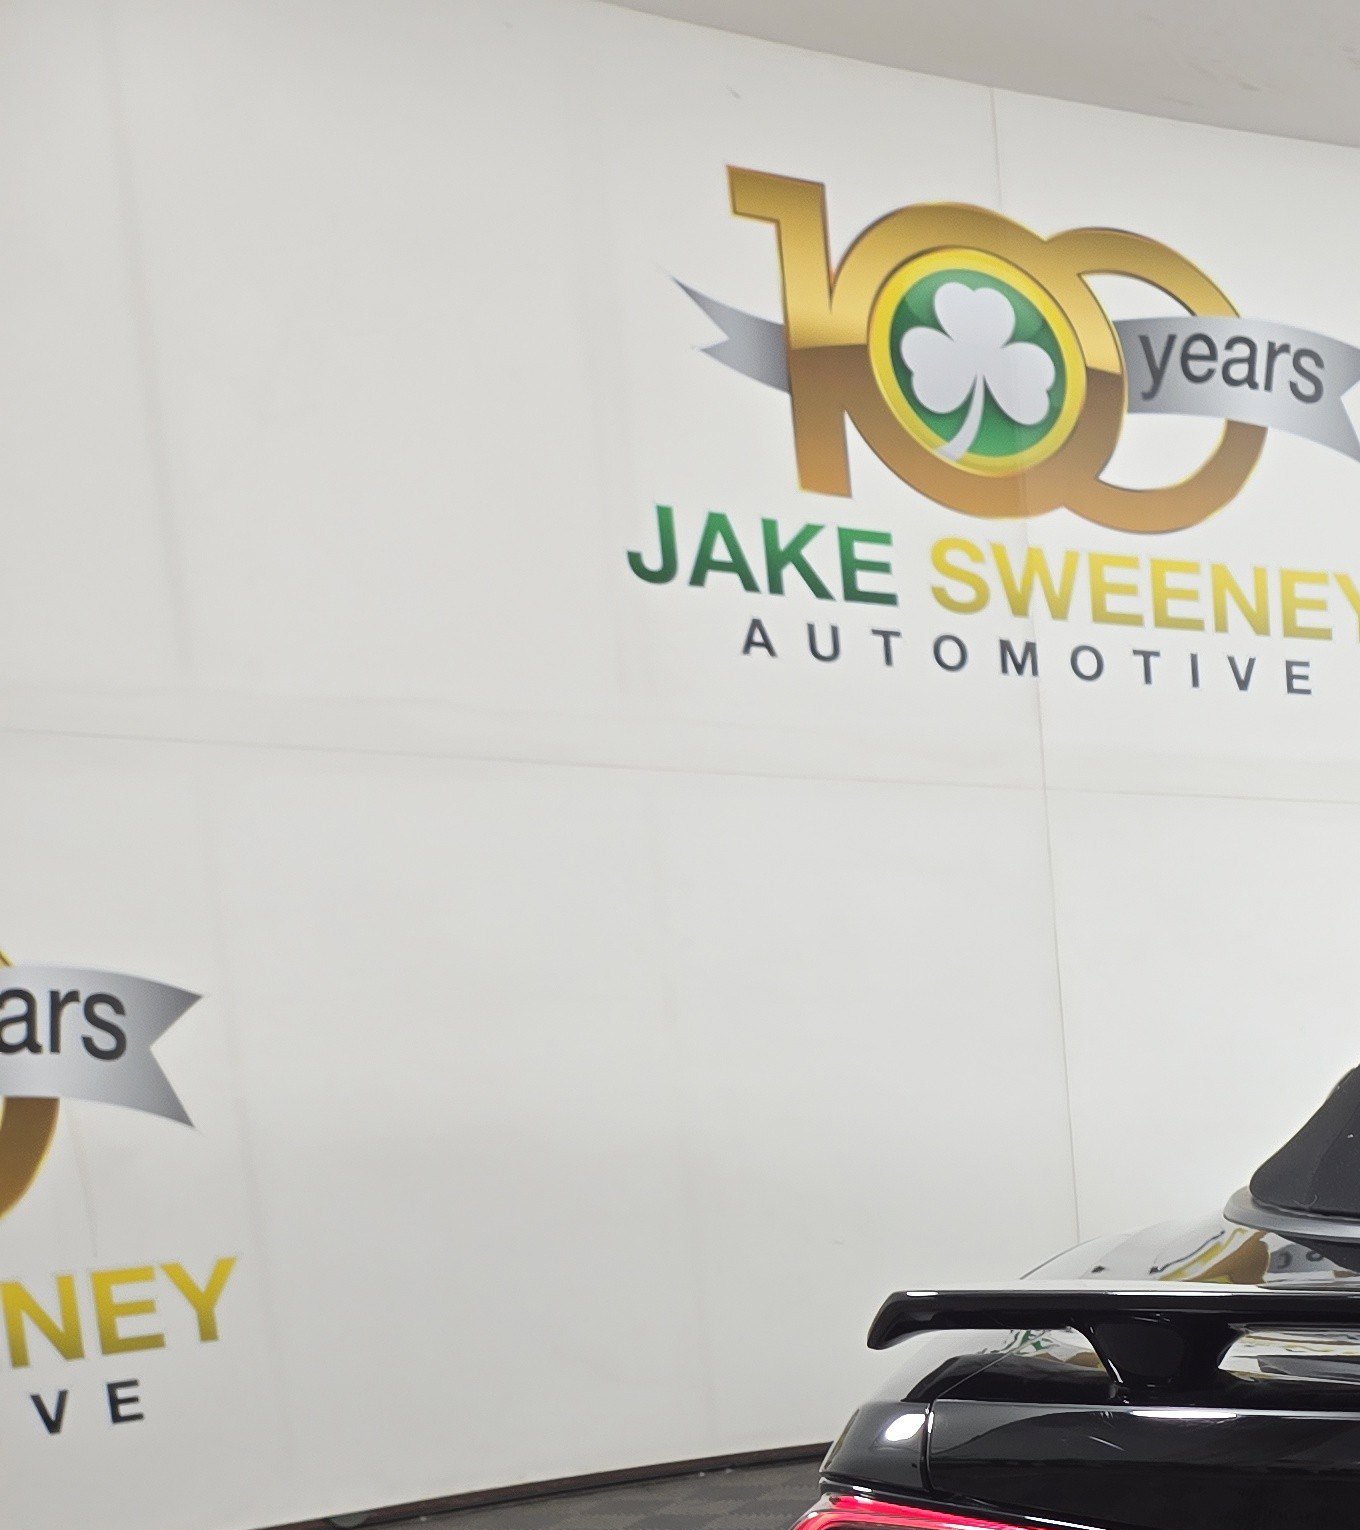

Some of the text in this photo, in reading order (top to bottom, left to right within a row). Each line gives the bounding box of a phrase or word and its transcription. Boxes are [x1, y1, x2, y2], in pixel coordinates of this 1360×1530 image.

[726, 164, 1325, 535] 100 years
[626, 504, 898, 607] JAKE
[742, 618, 1314, 696] AUTOMOTIVE
